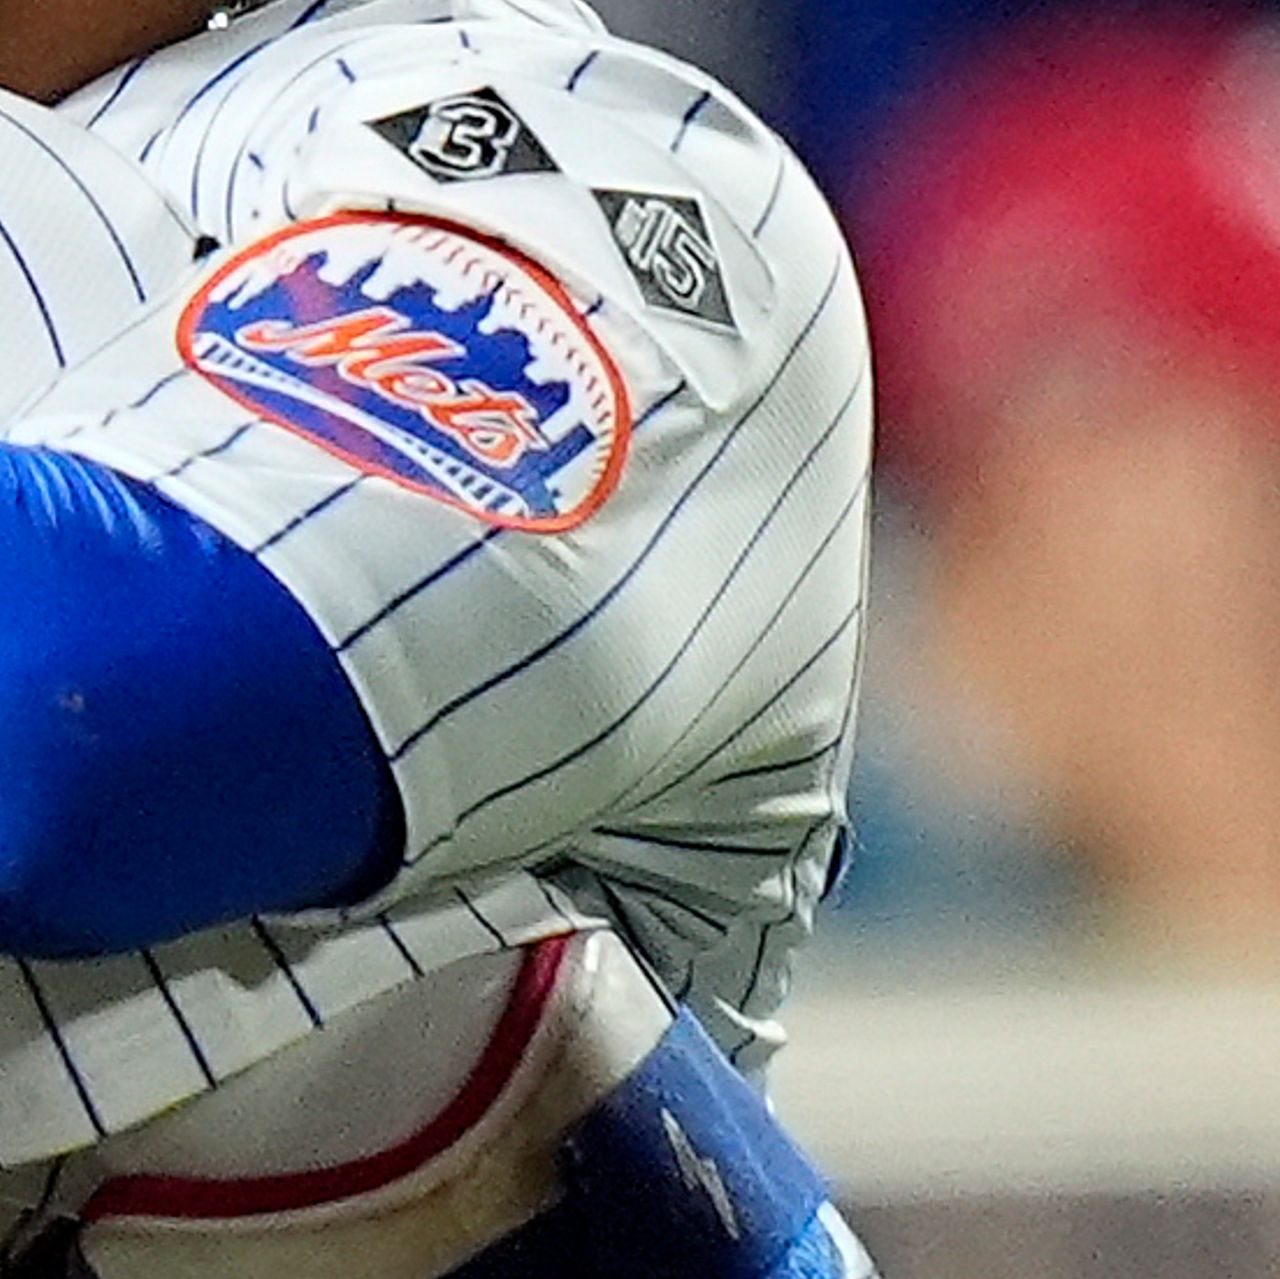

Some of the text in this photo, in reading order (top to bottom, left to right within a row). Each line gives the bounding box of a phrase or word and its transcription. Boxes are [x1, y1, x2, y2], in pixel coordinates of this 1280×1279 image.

[408, 96, 518, 180] 3
[614, 198, 719, 308] 15
[236, 306, 547, 469] Mets
